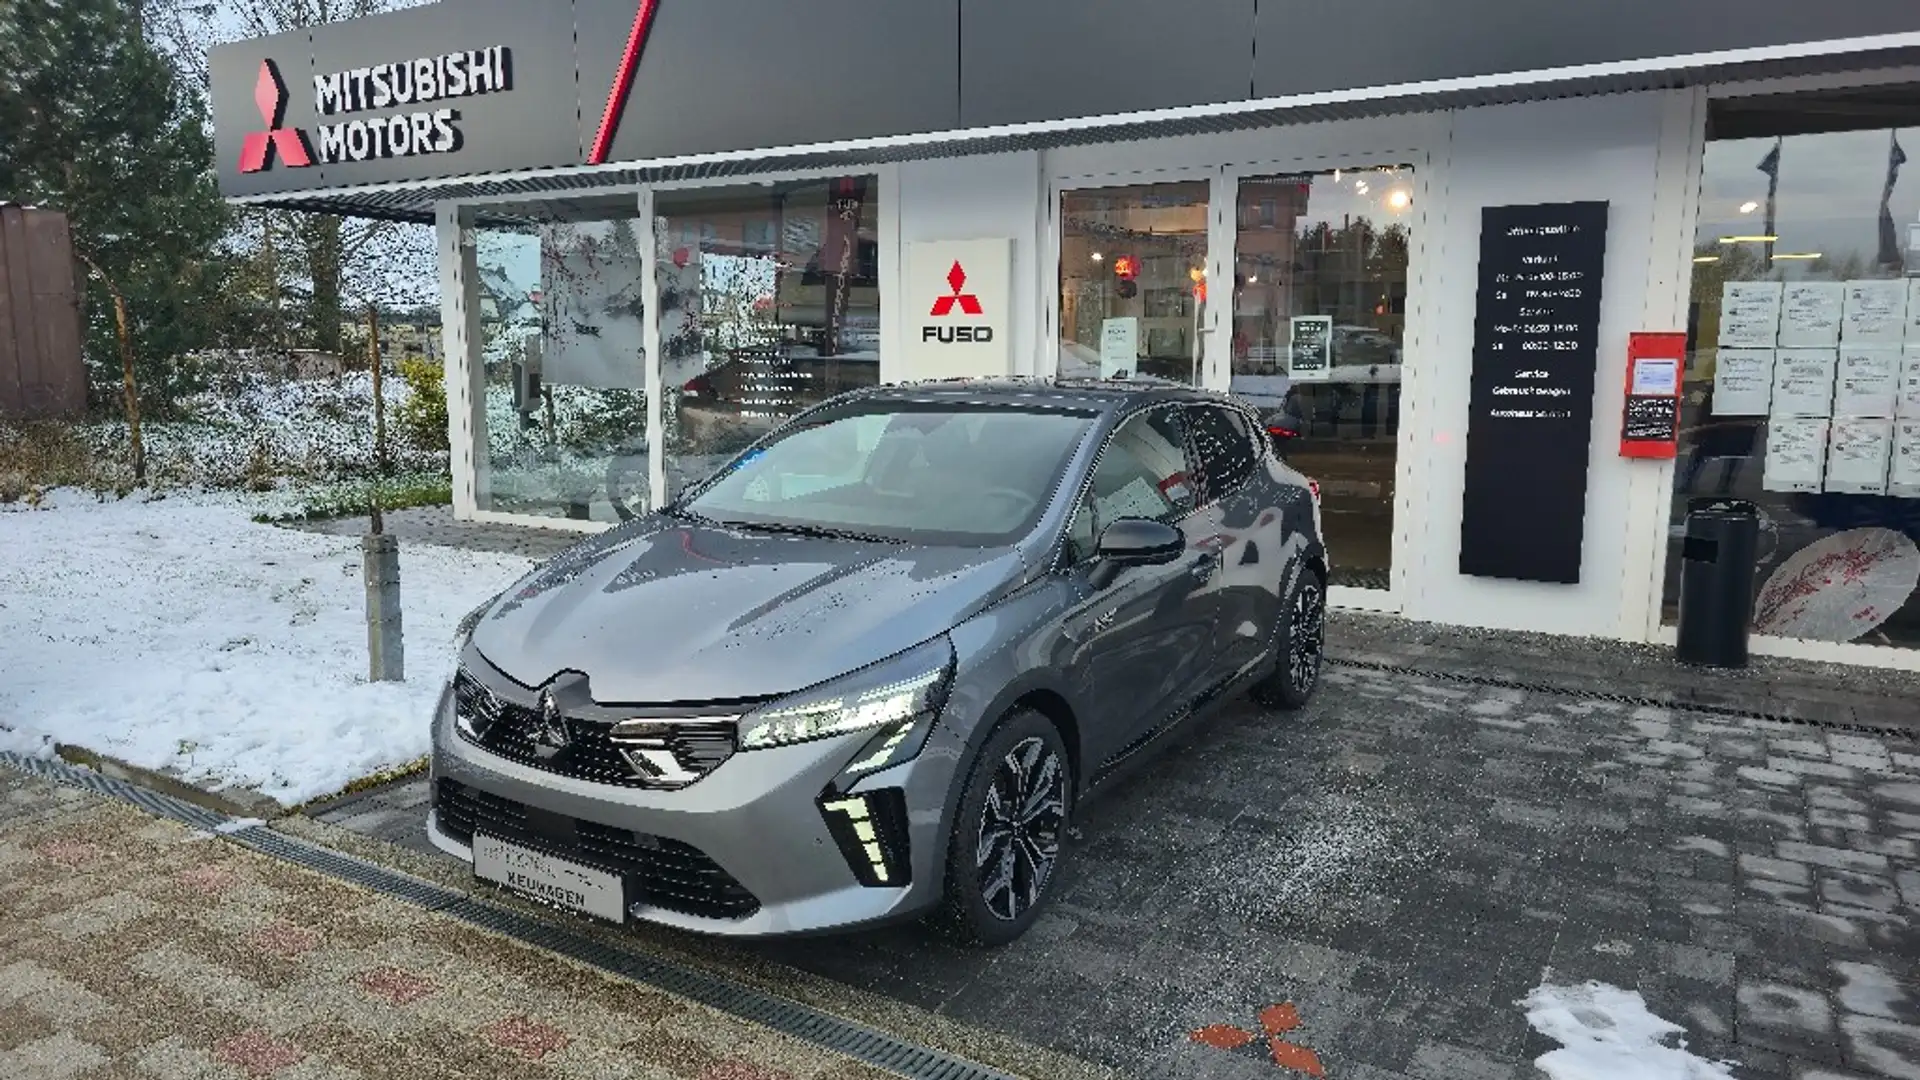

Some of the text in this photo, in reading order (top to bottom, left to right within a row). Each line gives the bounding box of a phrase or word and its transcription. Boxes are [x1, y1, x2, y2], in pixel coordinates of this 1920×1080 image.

[314, 45, 506, 114] MITSUBISHI
[318, 108, 458, 163] MOTORS
[922, 326, 993, 343] FUSO
